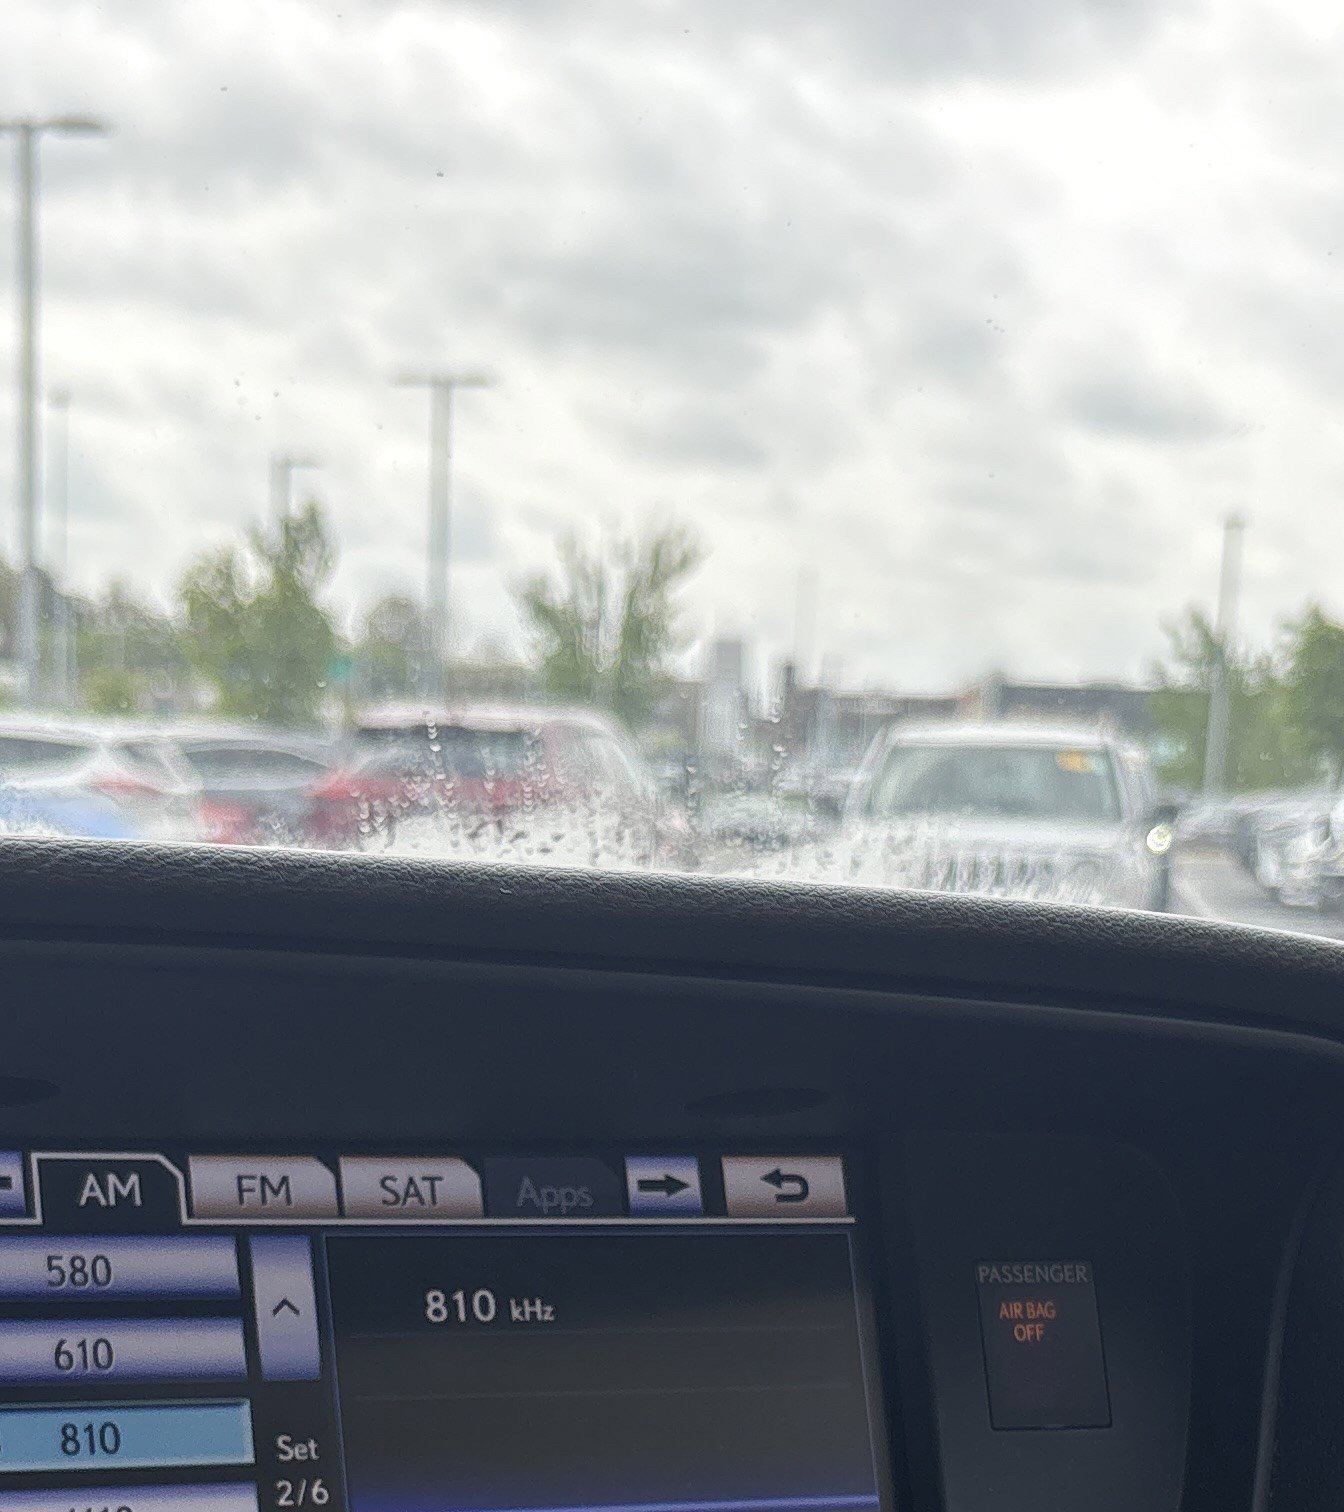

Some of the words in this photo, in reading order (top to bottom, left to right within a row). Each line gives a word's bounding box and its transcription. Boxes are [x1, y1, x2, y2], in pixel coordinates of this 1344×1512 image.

[78, 1172, 142, 1207] AM
[236, 1174, 293, 1206] FM
[379, 1174, 444, 1208] SAT
[516, 1176, 594, 1215] Apps
[46, 1255, 112, 1288] 580
[978, 1264, 1088, 1284] PASSENGER
[424, 1289, 496, 1324] 810
[509, 1298, 555, 1322] kHz
[999, 1302, 1023, 1320] AIR
[1027, 1301, 1056, 1319] BAG
[1013, 1323, 1046, 1343] OFF
[55, 1338, 114, 1371] 610
[60, 1421, 121, 1456] 810
[275, 1435, 319, 1463] Set
[275, 1479, 330, 1507] 2/6
